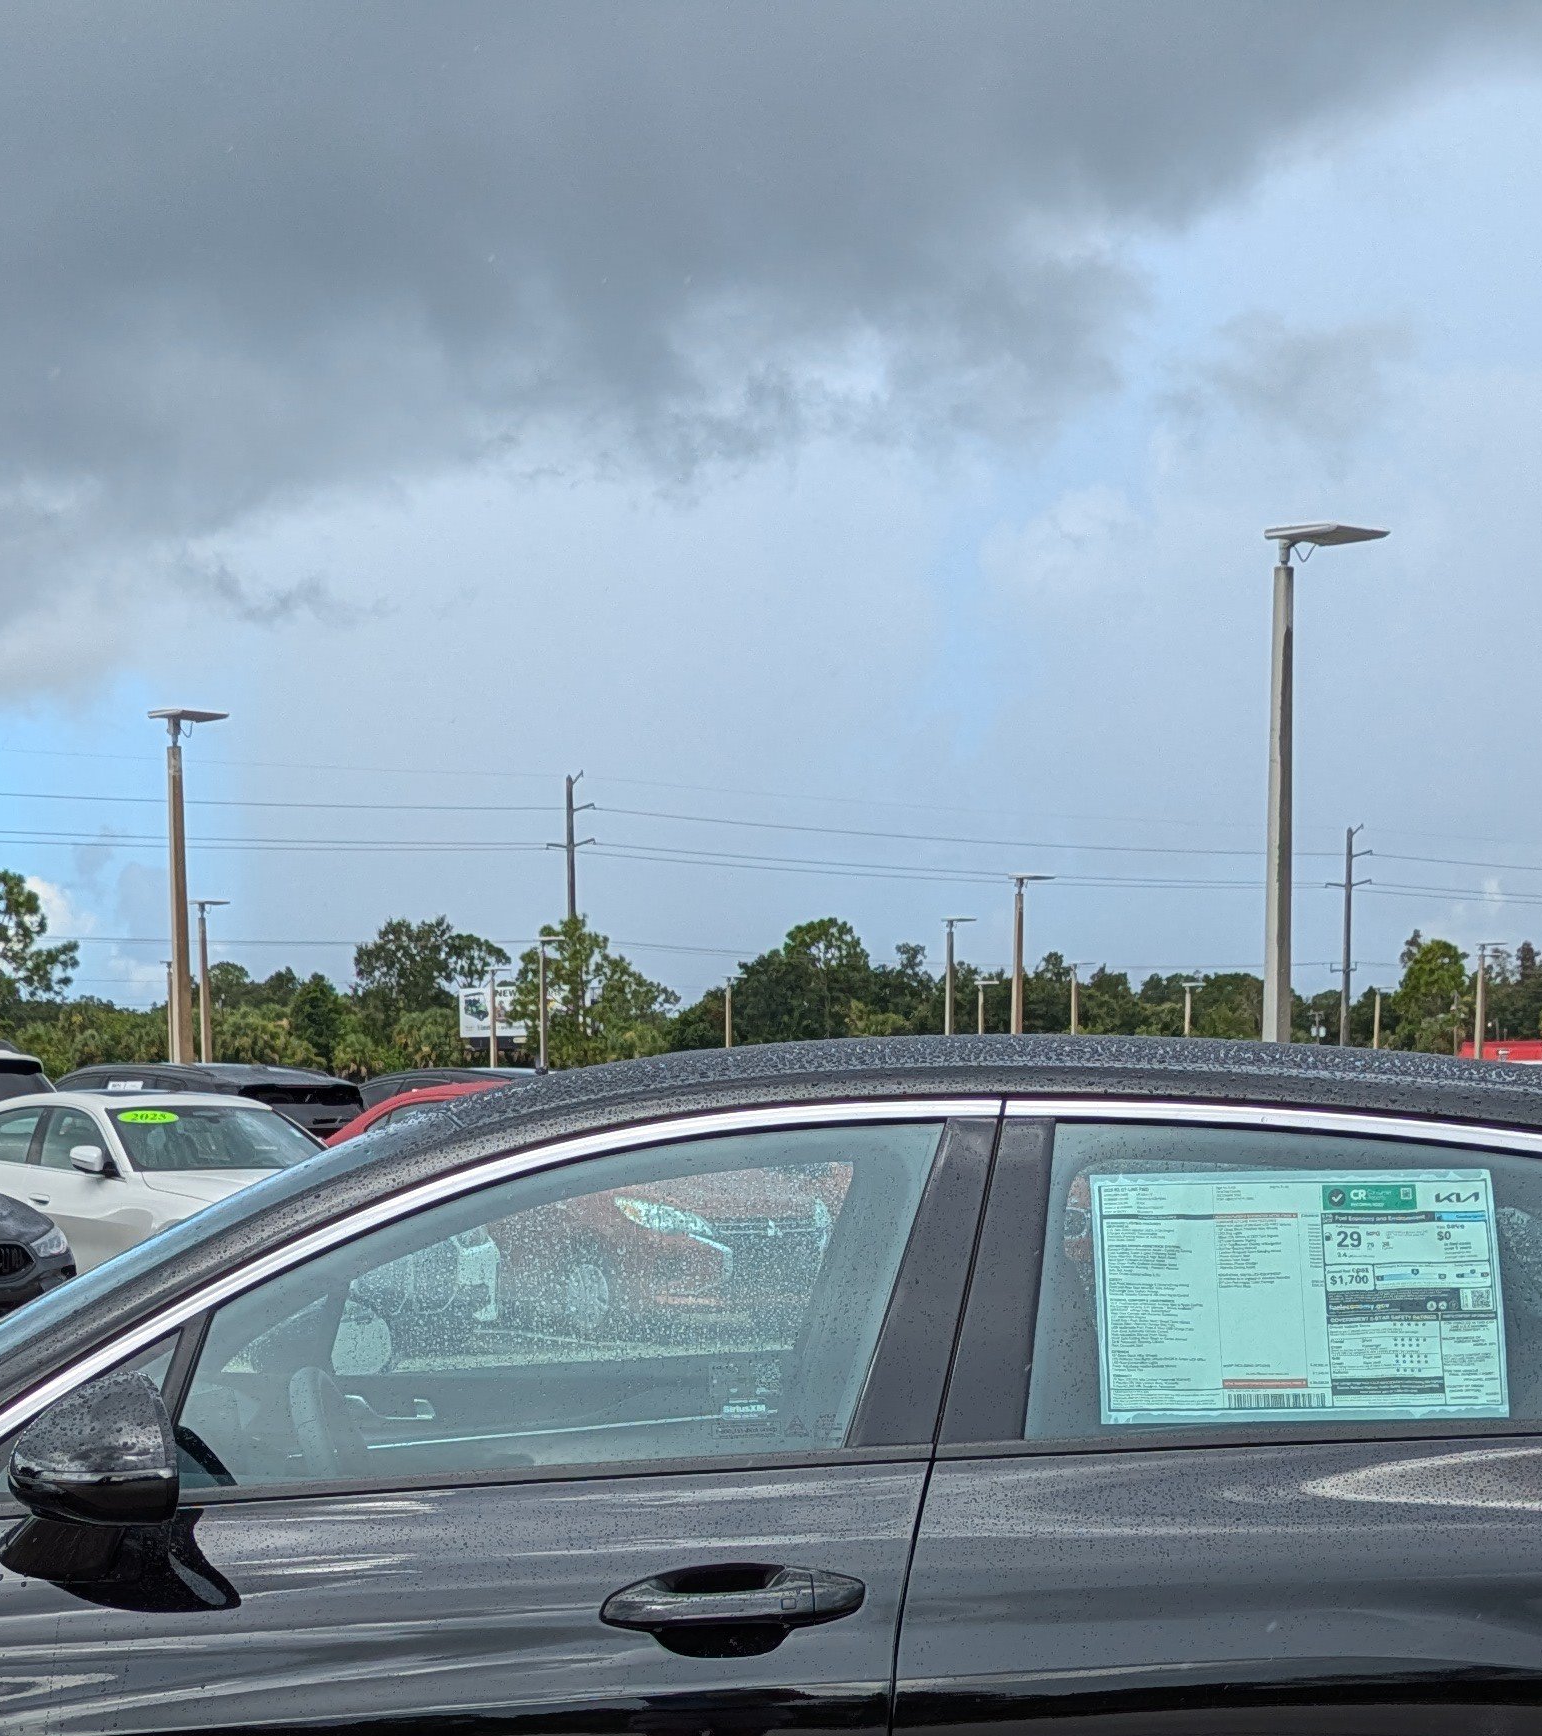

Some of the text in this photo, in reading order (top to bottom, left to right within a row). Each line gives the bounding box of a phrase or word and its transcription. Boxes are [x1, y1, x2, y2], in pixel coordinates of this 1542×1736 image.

[1350, 1189, 1366, 1200] CR
[1435, 1192, 1479, 1202] KIA
[1337, 1231, 1361, 1247] 29
[1437, 1231, 1451, 1241] $0
[1330, 1275, 1369, 1286] $1,700
[723, 1405, 766, 1413] SiriusXM
